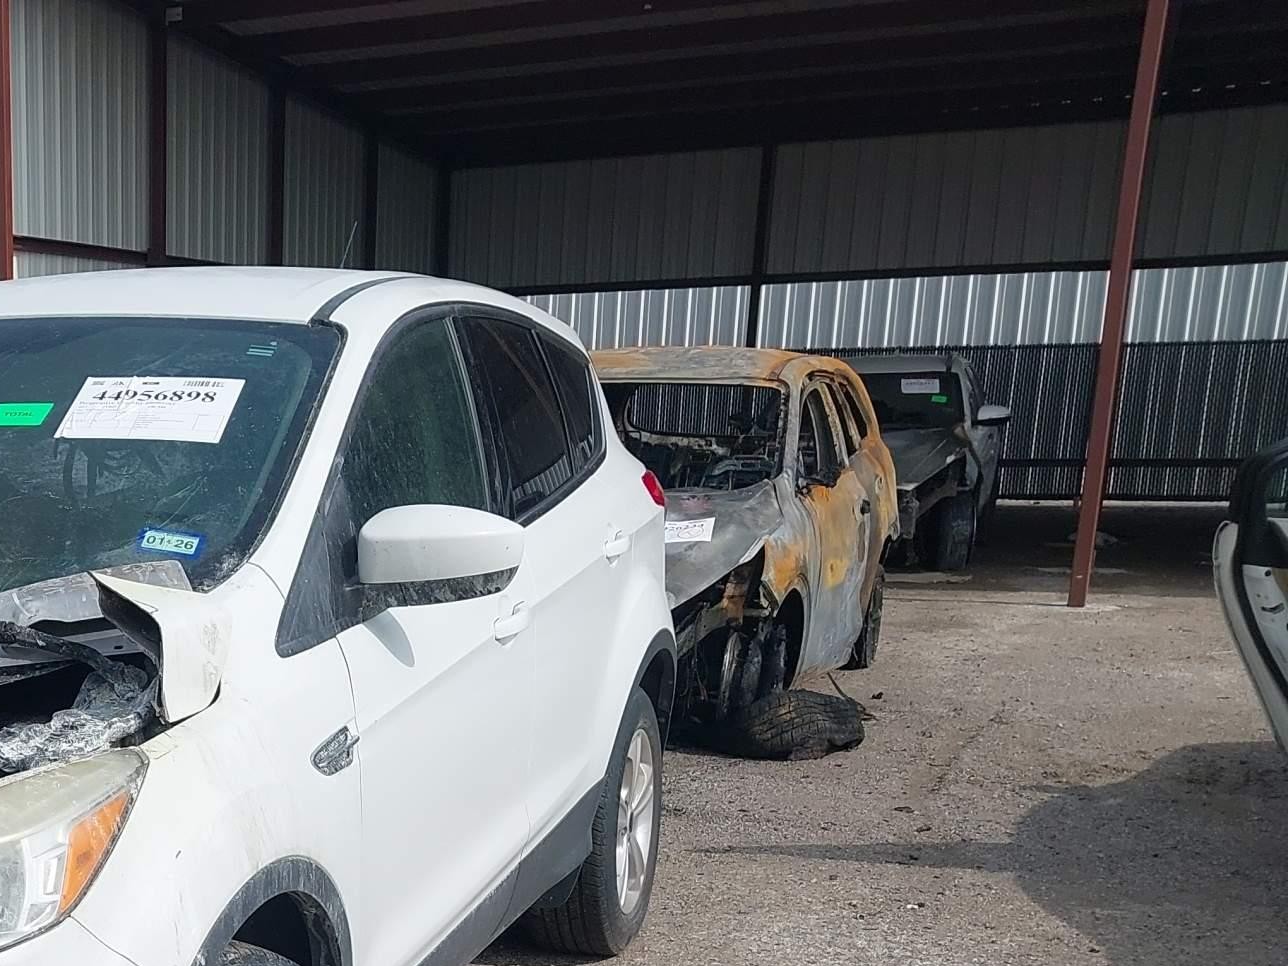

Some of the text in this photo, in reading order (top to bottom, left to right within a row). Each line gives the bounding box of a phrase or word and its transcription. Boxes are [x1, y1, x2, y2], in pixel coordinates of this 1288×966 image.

[92, 389, 217, 403] 44956898
[146, 535, 195, 550] 01 26
